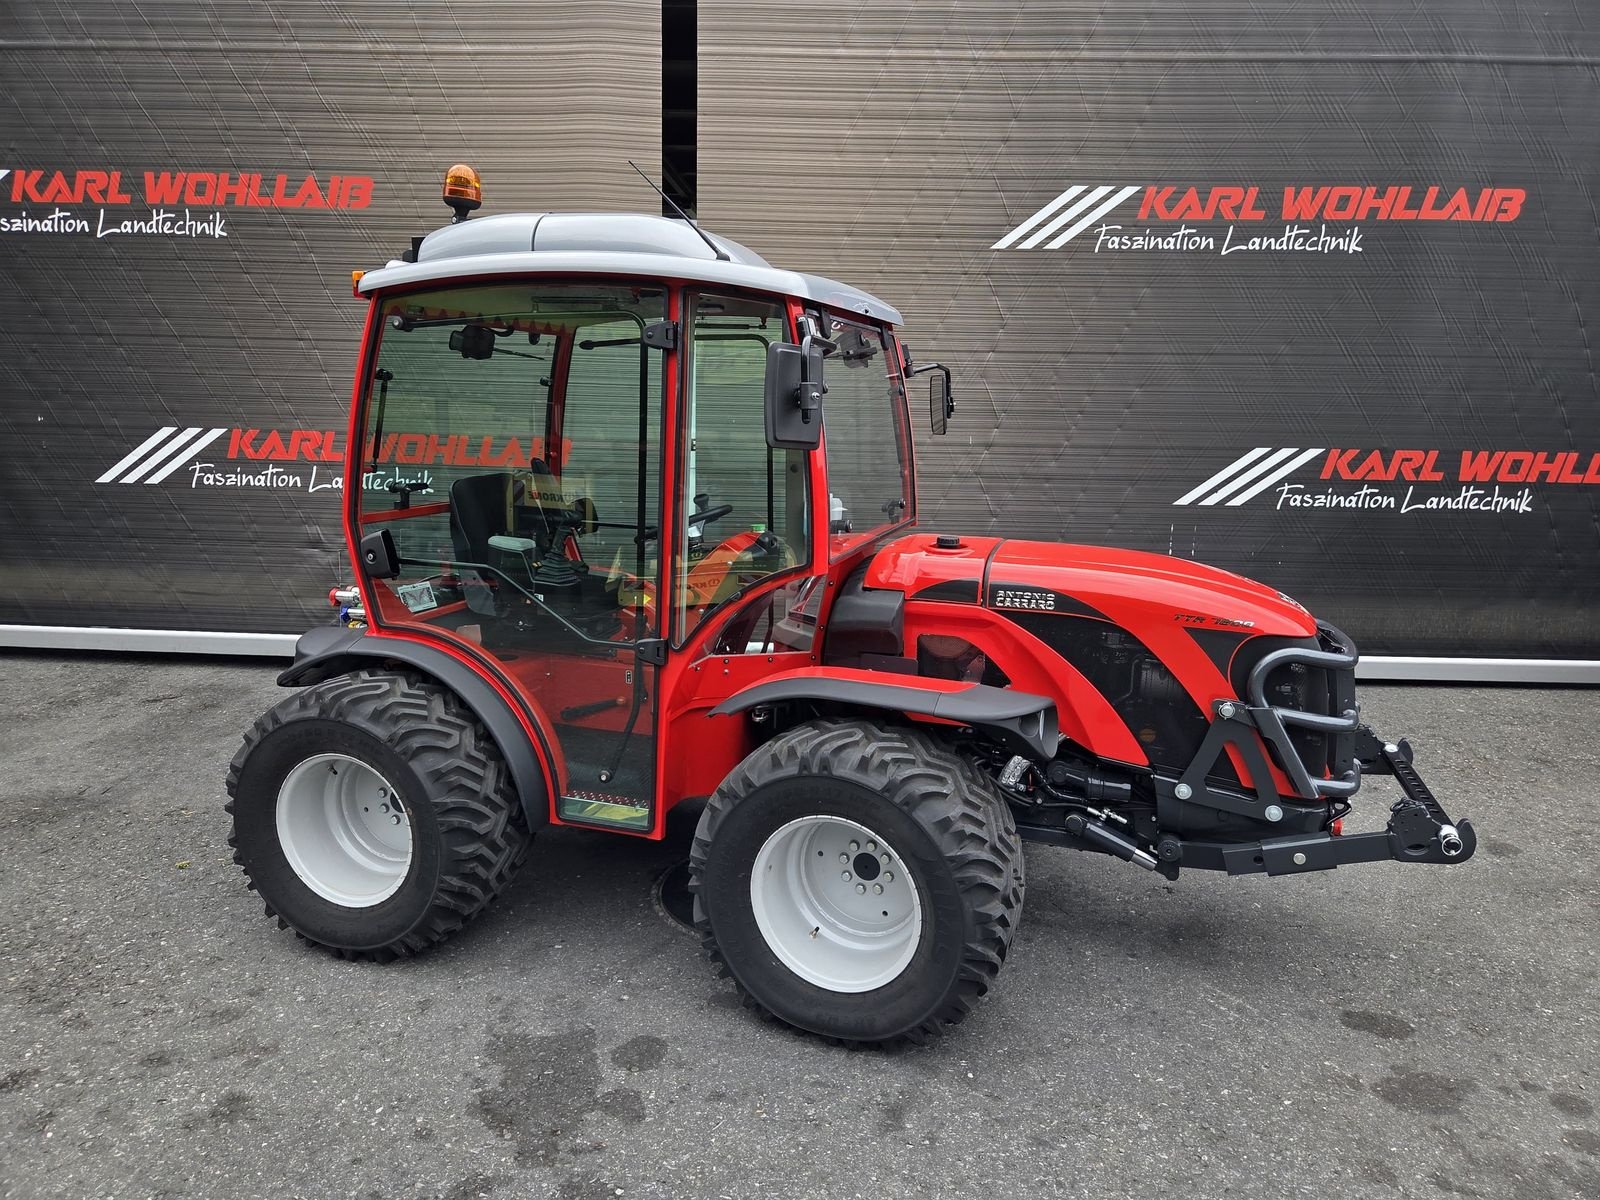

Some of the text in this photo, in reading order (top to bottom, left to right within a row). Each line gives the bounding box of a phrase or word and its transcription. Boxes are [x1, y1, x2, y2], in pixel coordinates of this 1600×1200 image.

[11, 169, 131, 203] KARL
[1136, 186, 1266, 220] KARL
[97, 208, 227, 239] Landtechnik
[1094, 223, 1363, 255] Faszination Landtechnik
[227, 428, 345, 462] KARL
[189, 461, 301, 489] Faszination
[1319, 448, 1445, 482] KARL
[1276, 483, 1532, 514] Faszination Landtechnik
[995, 597, 1056, 610] CARRARO
[996, 590, 1056, 601] ANTONIO
